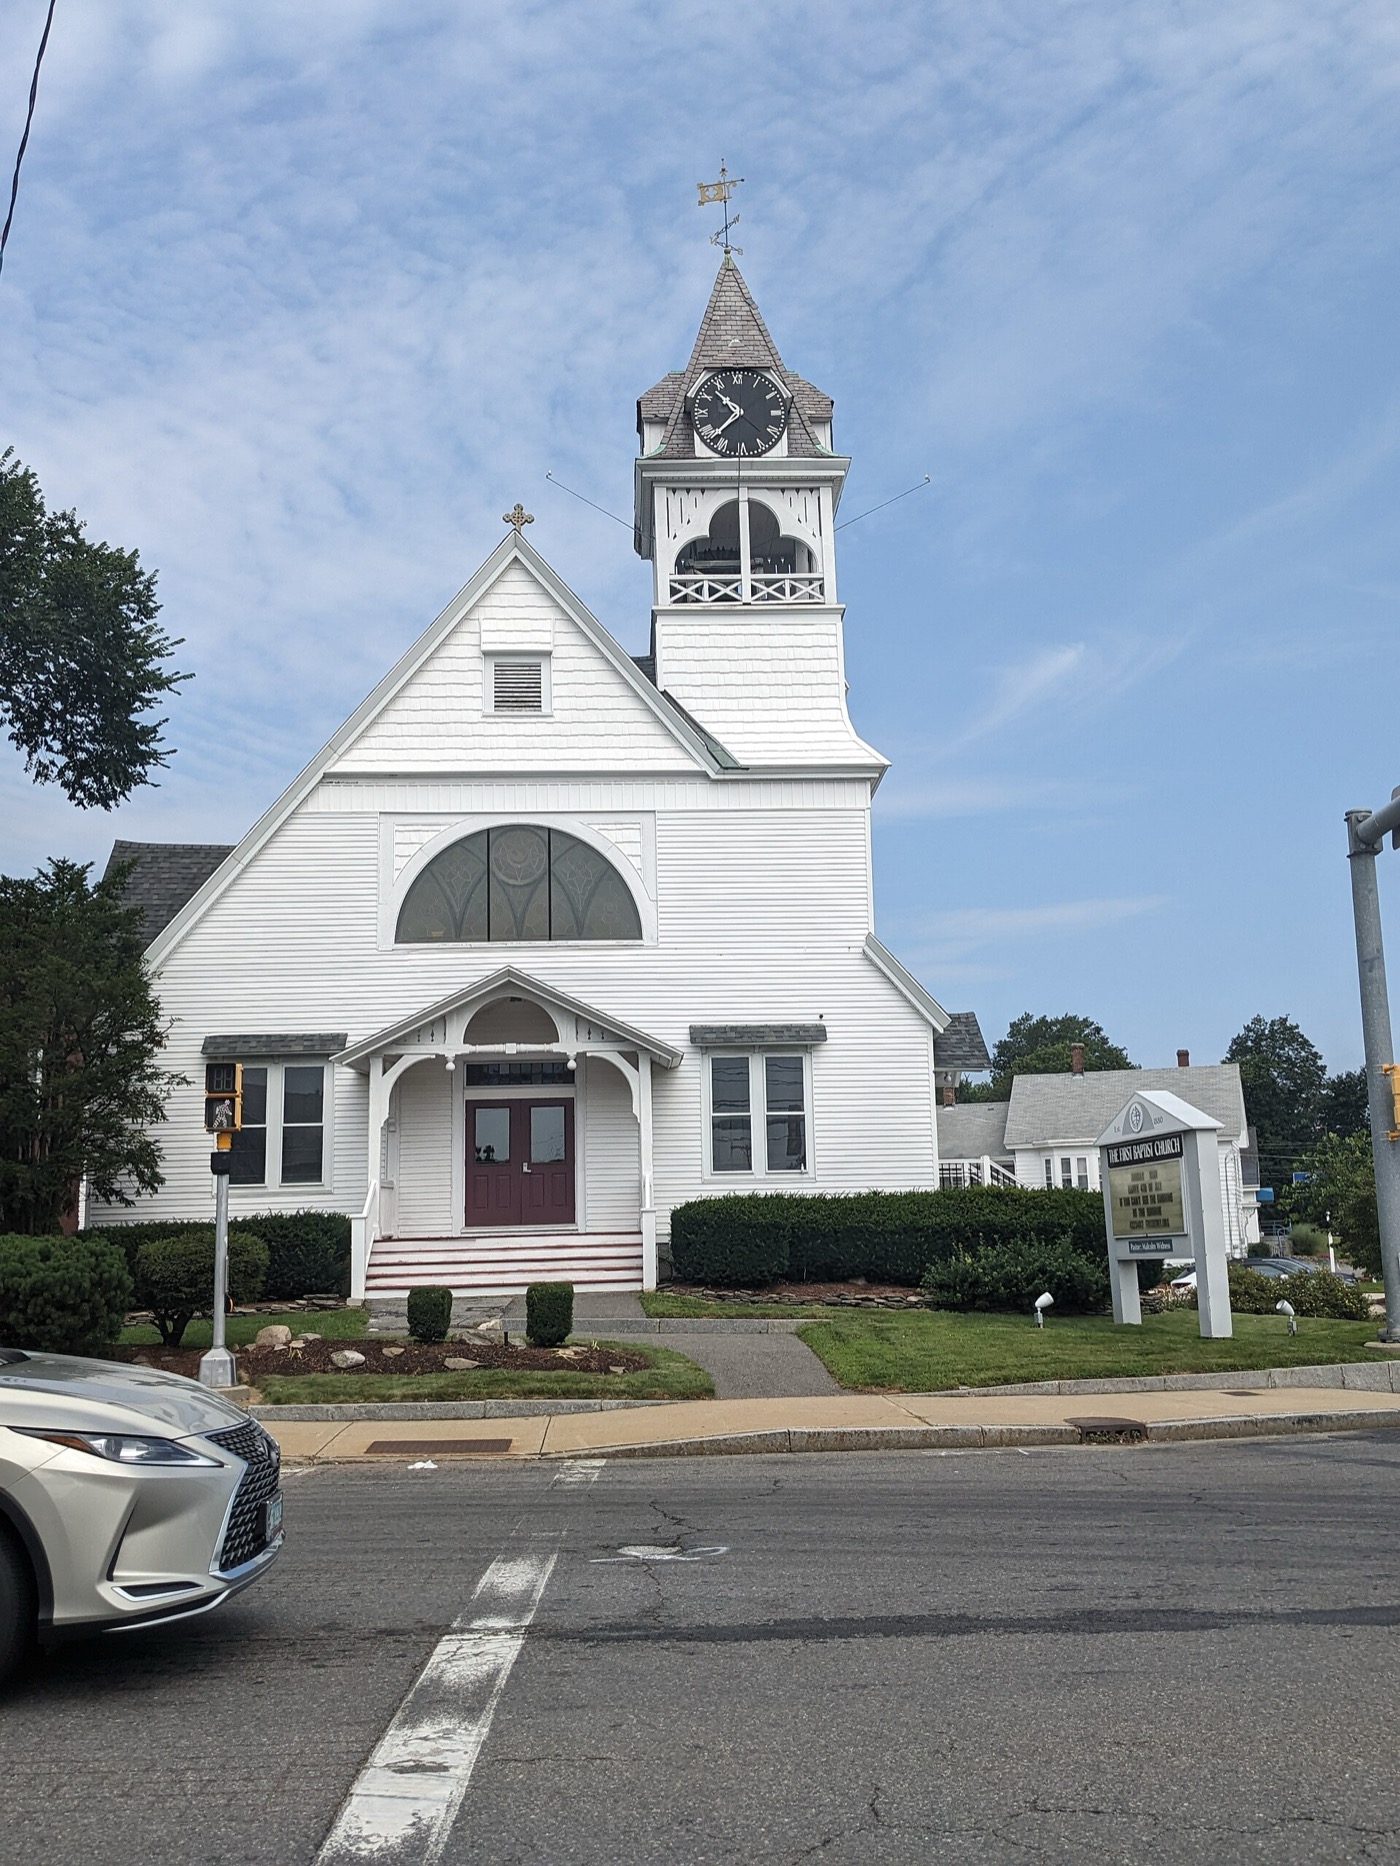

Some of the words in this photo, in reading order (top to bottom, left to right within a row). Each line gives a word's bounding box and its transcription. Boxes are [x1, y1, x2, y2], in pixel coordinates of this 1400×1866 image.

[1108, 1148, 1119, 1163] THE
[1119, 1146, 1133, 1162] FIRST
[1133, 1142, 1154, 1160] BAPTIST
[1154, 1137, 1181, 1156] CHURCH
